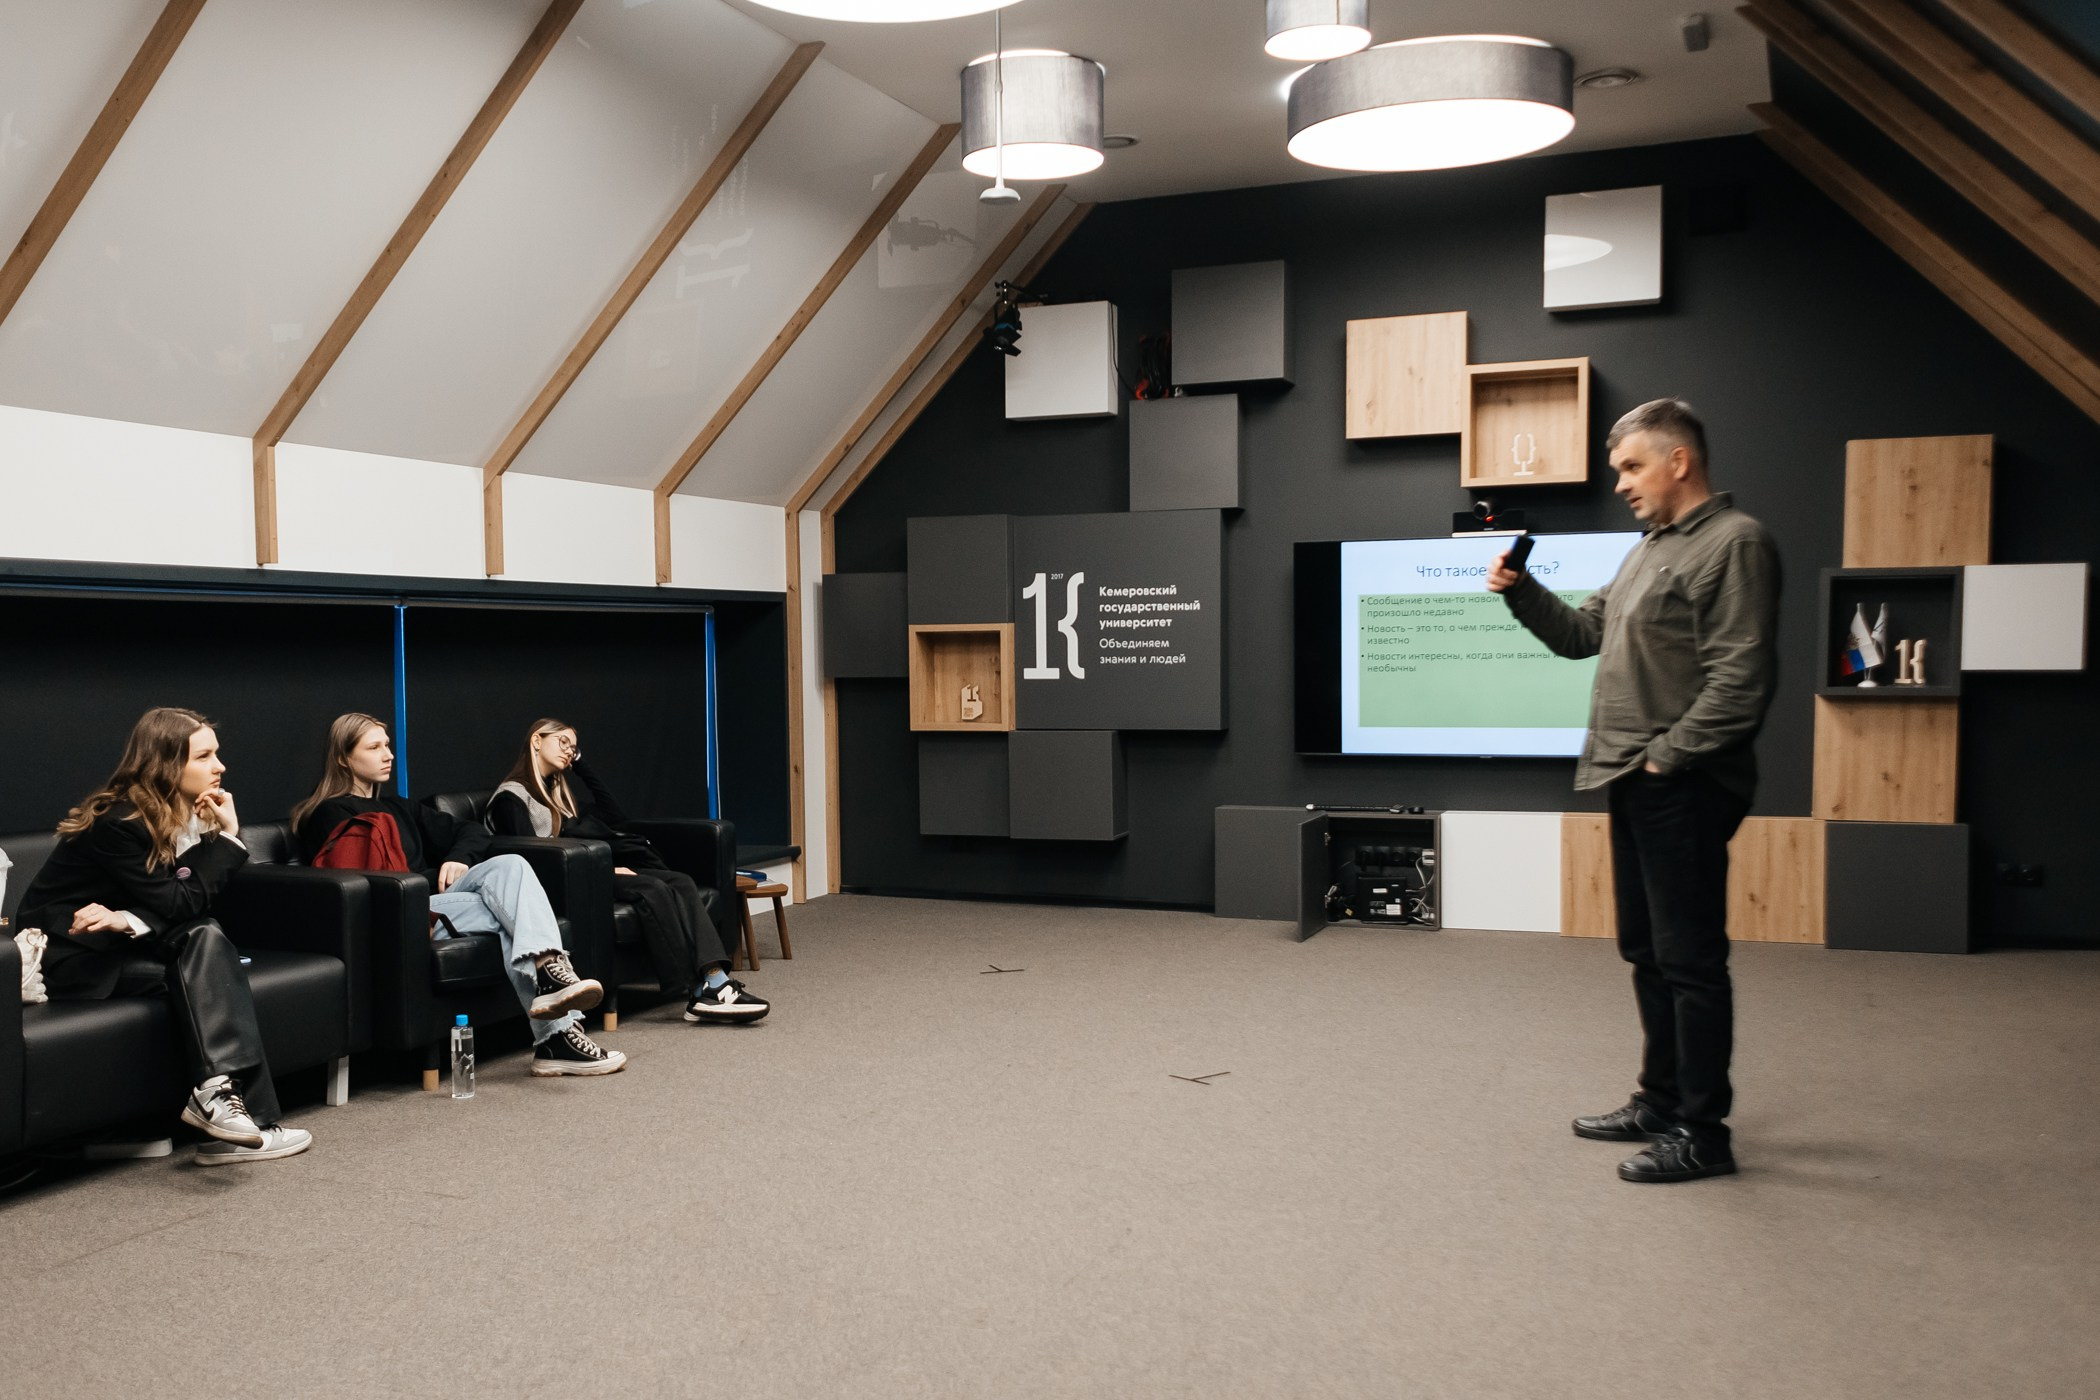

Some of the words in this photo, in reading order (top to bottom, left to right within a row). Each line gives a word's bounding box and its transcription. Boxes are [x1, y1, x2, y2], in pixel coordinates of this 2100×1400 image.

[1416, 565, 1442, 578] Что
[1445, 565, 1488, 577] такое
[1099, 584, 1177, 599] Кемеровский
[1367, 595, 1423, 606] Сообщение
[1424, 596, 1431, 605] о
[1432, 596, 1466, 605] чем-то
[1468, 595, 1500, 604] новом
[1099, 599, 1201, 615] государственный
[1367, 609, 1421, 619] произошло
[1423, 608, 1465, 618] недавно
[1099, 617, 1173, 630] университет
[1367, 625, 1406, 633] Новость
[1416, 625, 1432, 633] это
[1434, 625, 1447, 634] то,
[1449, 624, 1456, 632] о
[1458, 624, 1477, 632] чем
[1479, 623, 1518, 633] прежде
[1099, 638, 1170, 651] Объединяем
[1367, 637, 1410, 645] известно
[1099, 655, 1137, 664] знания
[1139, 655, 1147, 664] и
[1149, 653, 1187, 666] людей
[1367, 652, 1407, 661] Новости
[1408, 652, 1464, 662] интересны,
[1466, 652, 1493, 661] когда
[1495, 651, 1514, 660] они
[1517, 651, 1551, 660] важны
[1367, 664, 1417, 673] необычны
